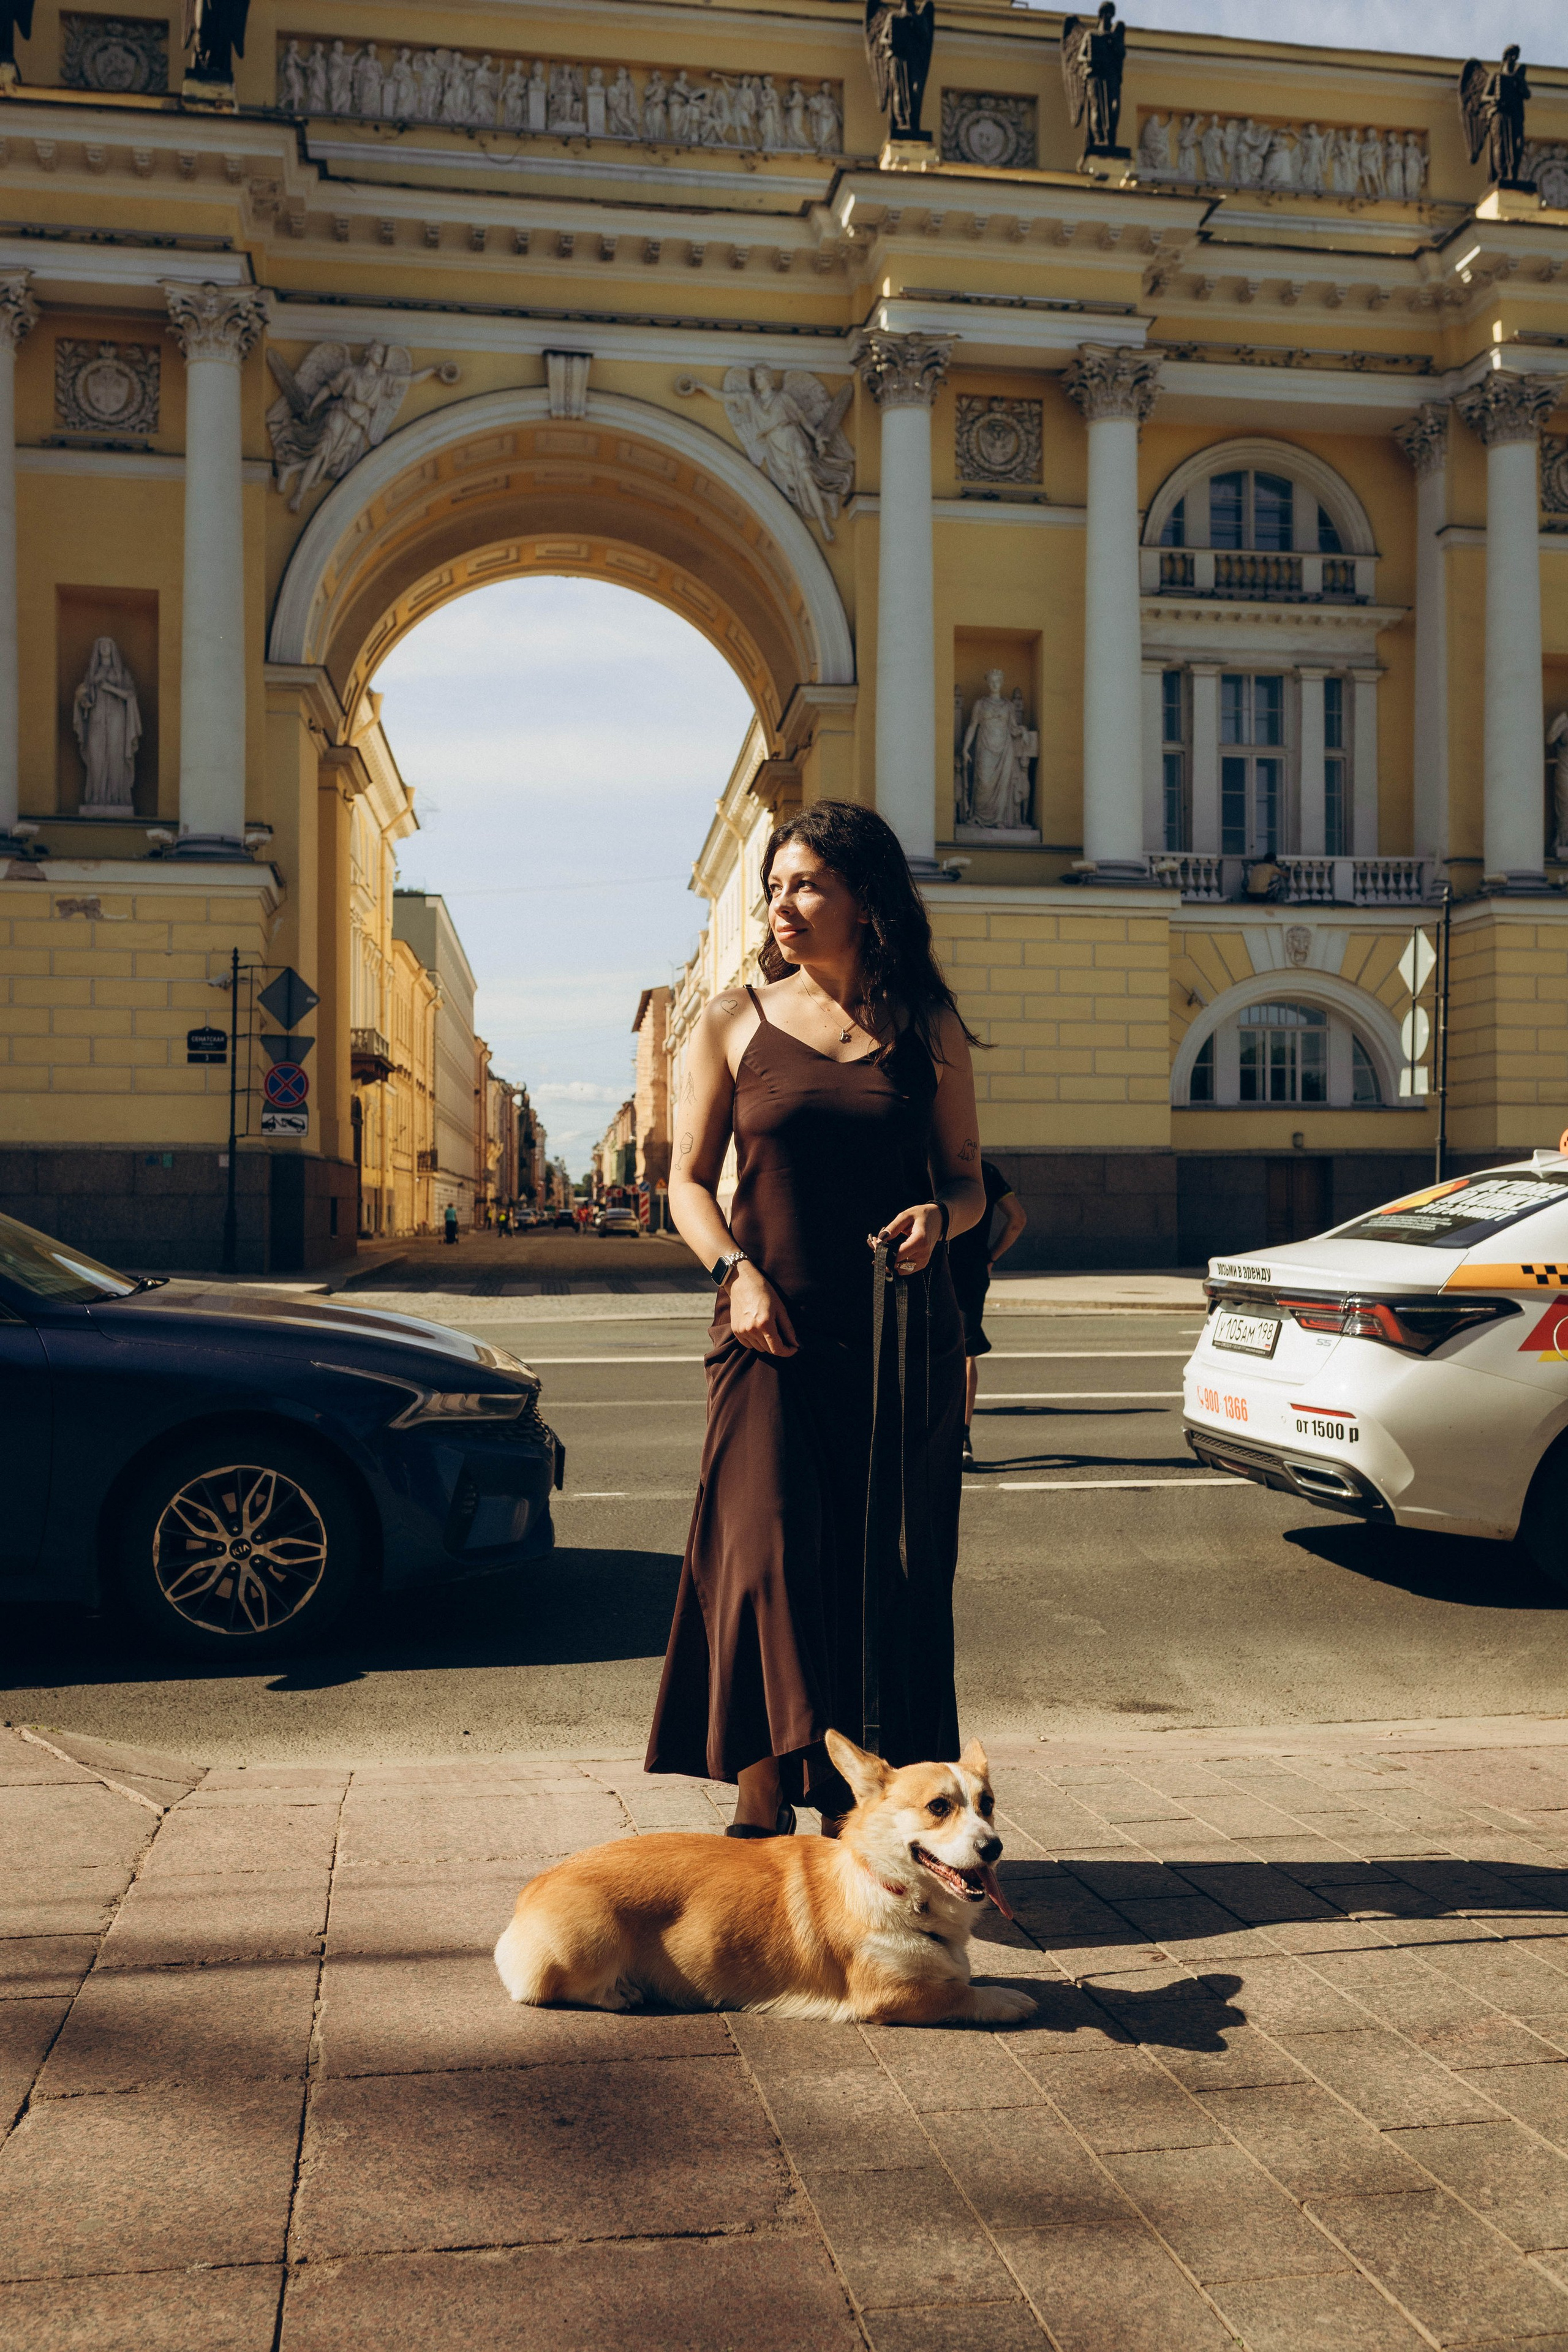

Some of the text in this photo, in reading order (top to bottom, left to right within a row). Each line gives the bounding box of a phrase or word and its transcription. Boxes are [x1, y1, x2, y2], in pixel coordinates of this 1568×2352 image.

[1238, 1266, 1242, 1278] в
[1243, 1267, 1271, 1283] аренду
[1258, 1322, 1273, 1340] 198
[1204, 1388, 1248, 1422] 900 1366
[1311, 1420, 1344, 1440] 1500
[232, 1544, 250, 1556] KIA
